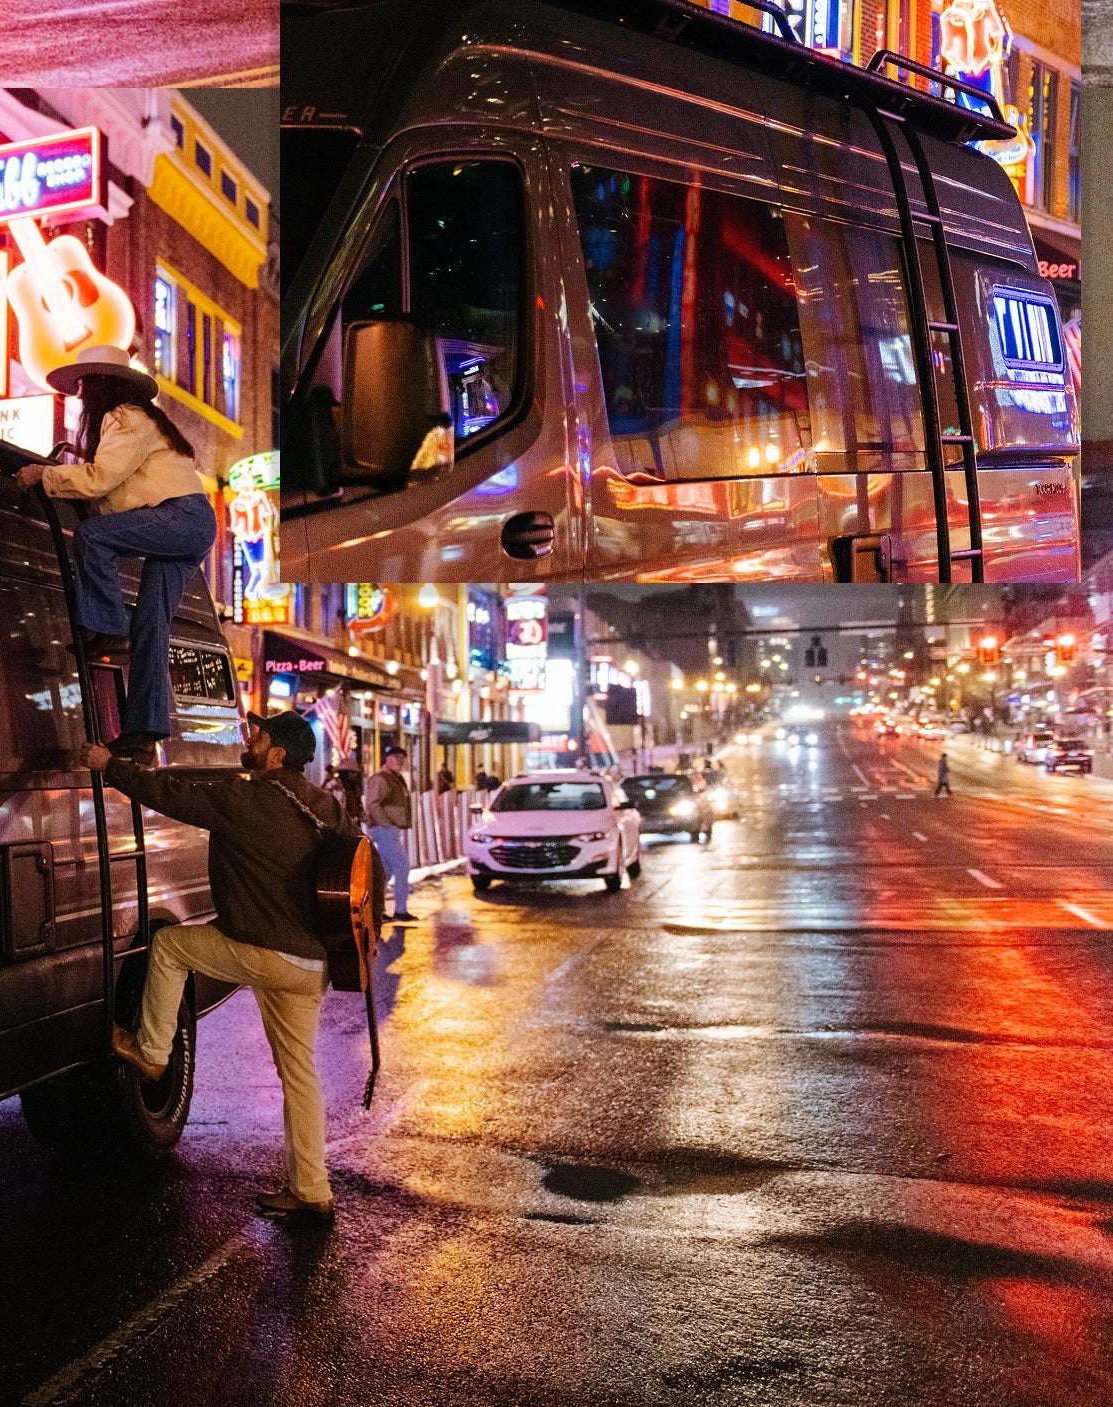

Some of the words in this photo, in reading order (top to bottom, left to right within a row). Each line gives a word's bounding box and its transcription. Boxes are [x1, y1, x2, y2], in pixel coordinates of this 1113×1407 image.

[1037, 260, 1077, 279] Beer
[265, 659, 293, 673] Pizza
[299, 659, 326, 672] Beer
